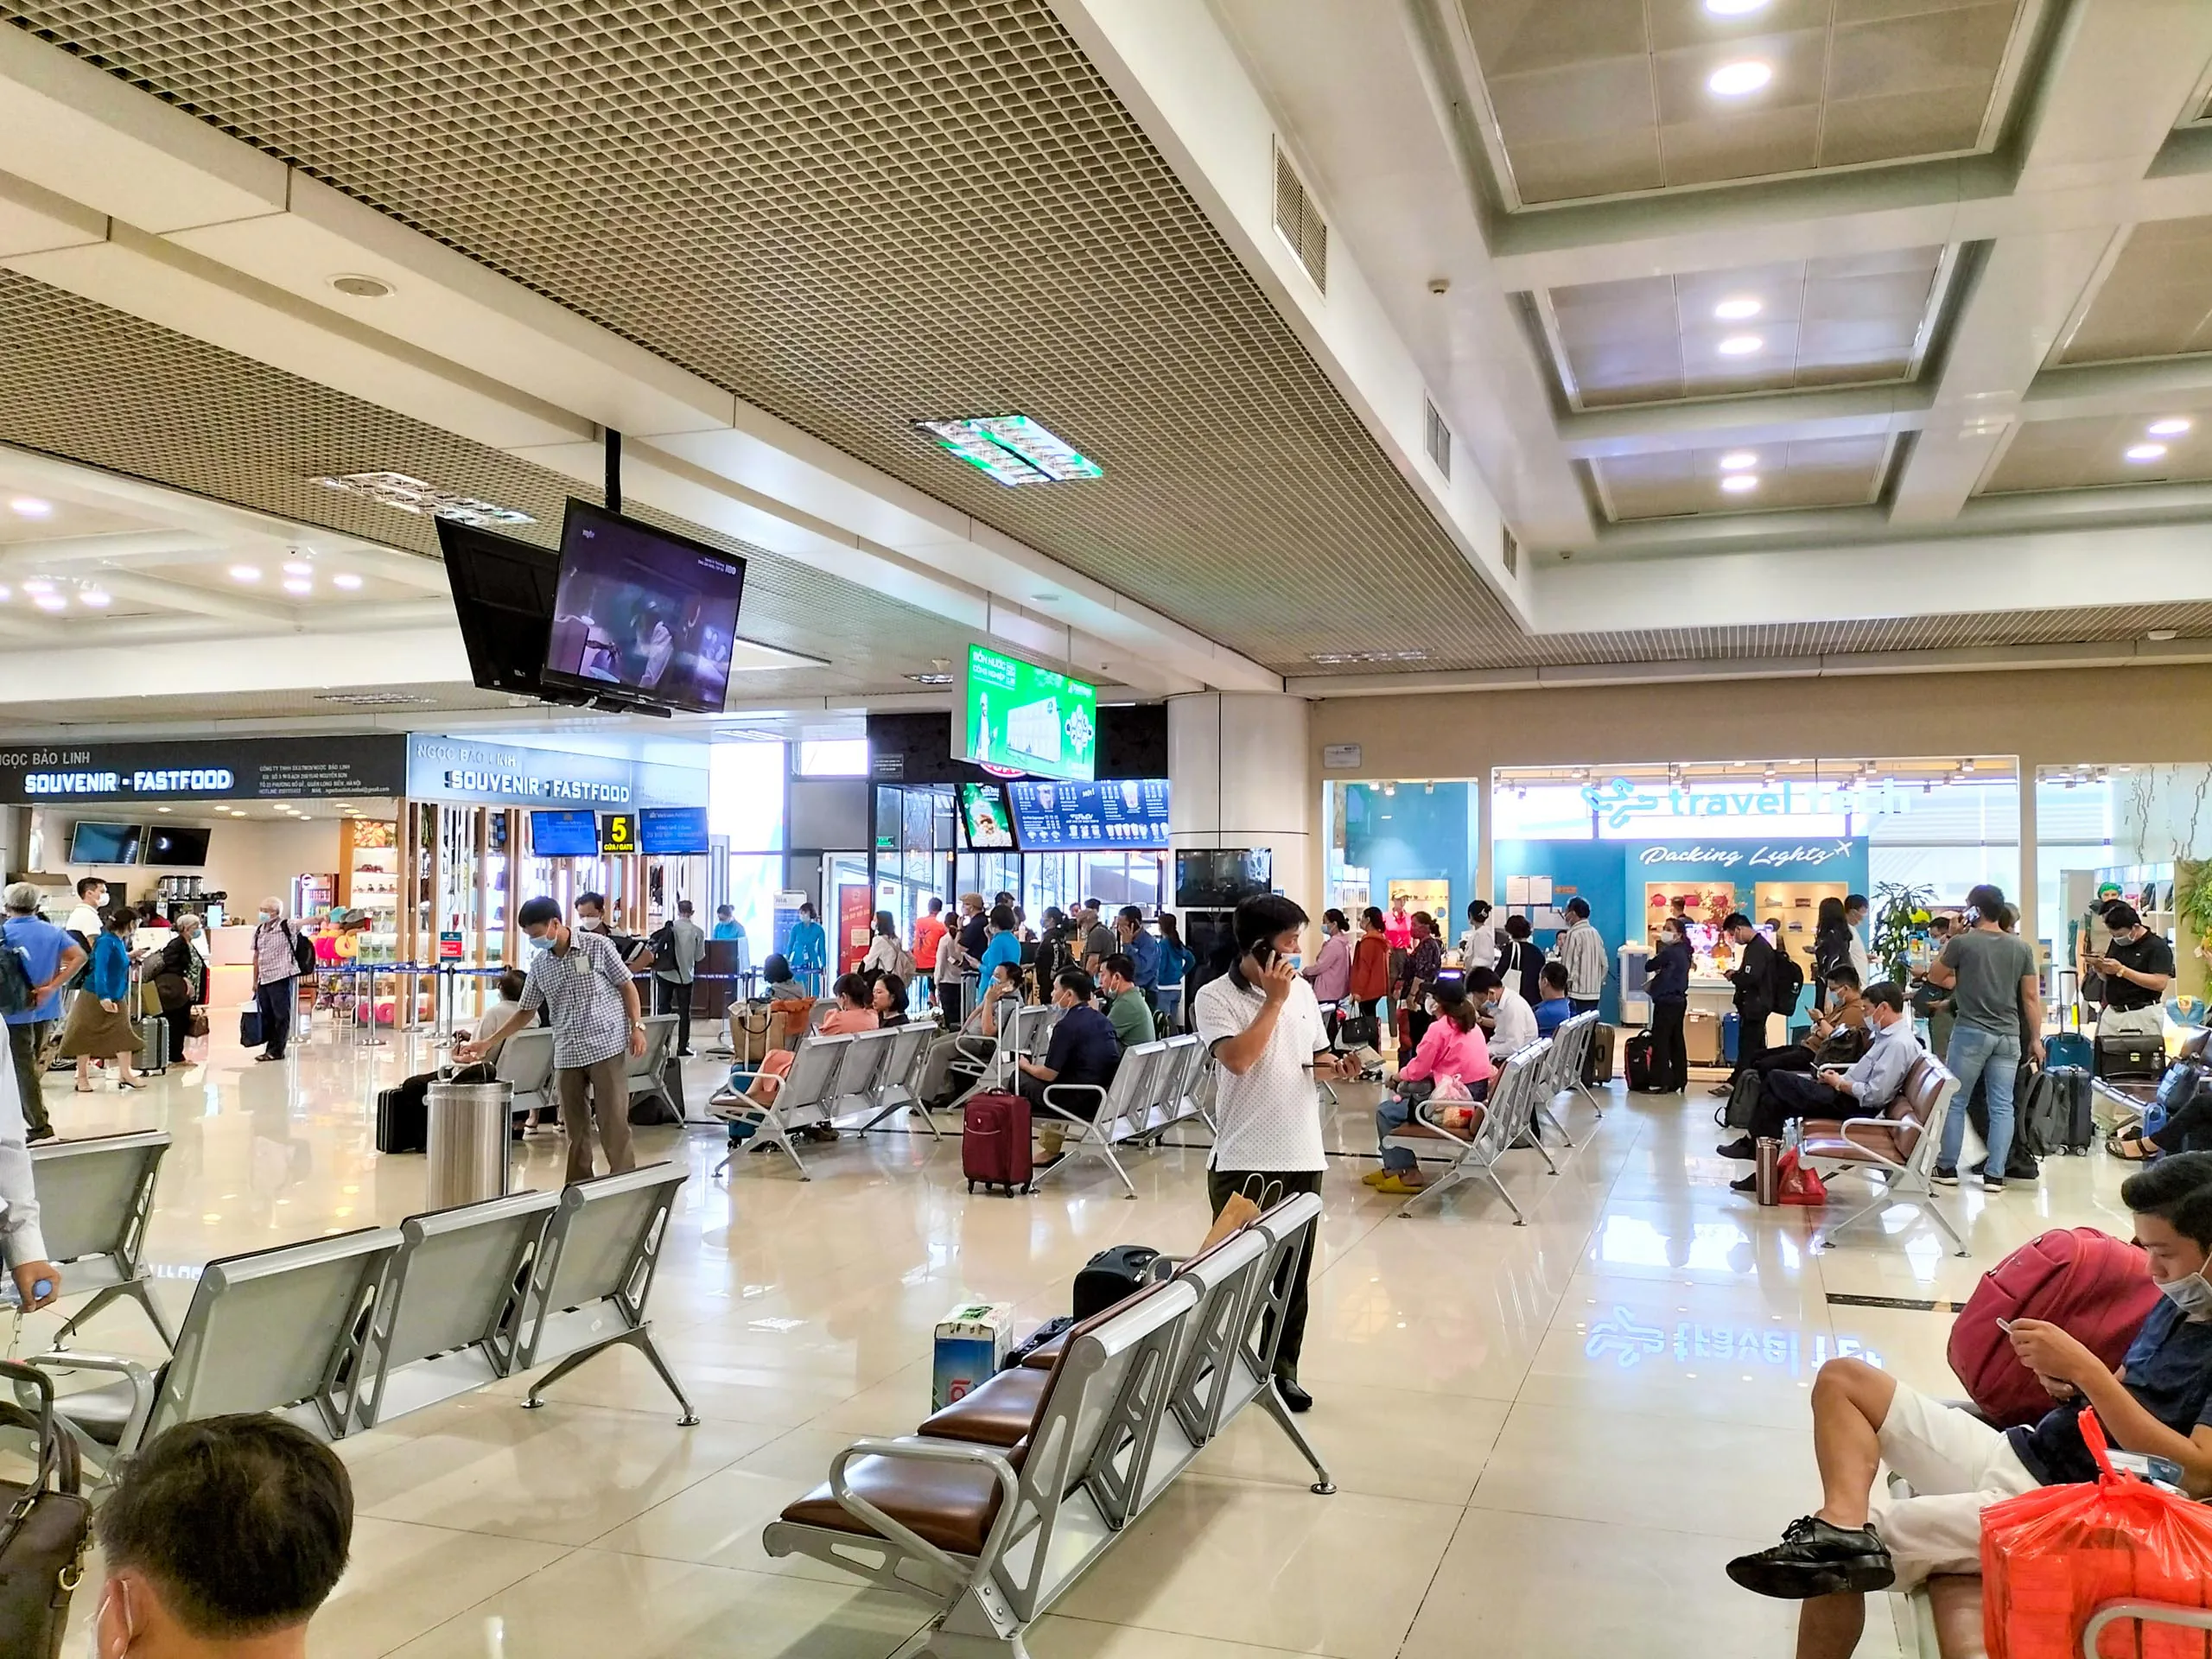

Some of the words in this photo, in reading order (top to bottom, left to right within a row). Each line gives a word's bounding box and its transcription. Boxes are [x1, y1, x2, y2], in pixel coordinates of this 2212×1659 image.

[0, 753, 29, 769] GỌC
[32, 748, 58, 765] BẢO
[63, 752, 90, 765] LINH
[24, 772, 118, 793] SOUVENIR
[133, 770, 233, 791] FASTFOOD
[448, 770, 539, 796] SOUVENIR
[551, 779, 630, 803] FASTFOOD
[1669, 780, 1791, 816] travel
[611, 817, 627, 842] 5
[1639, 845, 1744, 868] Packing
